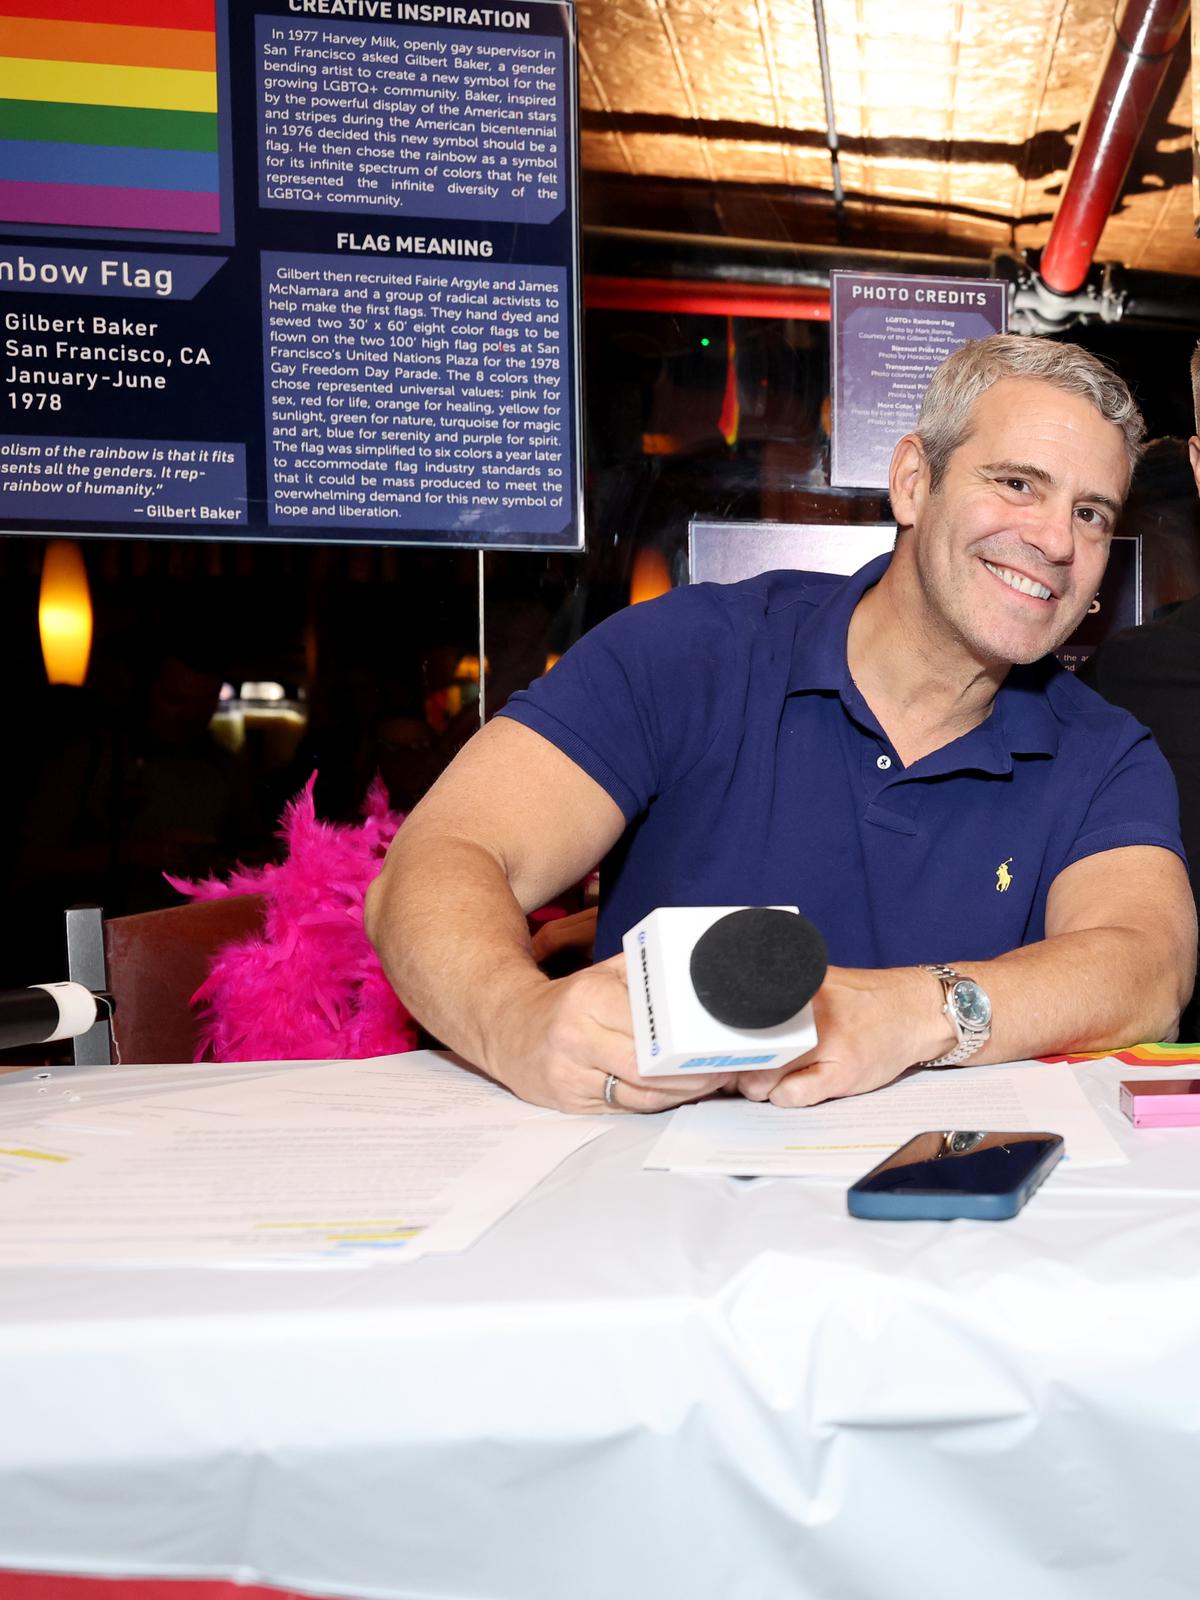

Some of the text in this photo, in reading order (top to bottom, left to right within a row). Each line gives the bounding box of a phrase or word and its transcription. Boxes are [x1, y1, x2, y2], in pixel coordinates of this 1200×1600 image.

[289, 0, 529, 28] CREATIVE INSPIRATION
[273, 29, 555, 59] In 1977 Harvey Milk, openly gay supervisor in
[264, 60, 556, 90] bending artist to create a new symbol for the
[265, 92, 556, 122] by the powerful display of the American stars
[266, 124, 557, 152] in 1976 decided this new symbol should be a
[266, 155, 557, 184] for its infinite spectrum of colors that he felt
[268, 187, 403, 208] LGBTQ+ community.
[337, 233, 493, 257] FLAG MEANING
[102, 261, 172, 295] Flag
[277, 268, 558, 292] Gilbert then recruited Fairie Argyle and James
[853, 285, 986, 305] PHOTO CREDITS
[6, 313, 158, 336] Gilbert Baker
[6, 340, 210, 367] San Francisco, CA
[6, 366, 165, 390] January-June
[271, 362, 560, 387] Gay Freedom Day Parade. The 8 colors they
[9, 393, 61, 410] 1978
[273, 410, 561, 433] sunlight, green for nature, turquoise for magic
[45, 445, 60, 456] of
[63, 446, 86, 457] the
[90, 447, 149, 459] rainbow
[152, 448, 163, 460] is
[168, 449, 196, 461] that
[199, 450, 208, 462] it
[212, 451, 234, 463] fits
[45, 463, 63, 474] all
[67, 464, 90, 475] the
[94, 465, 156, 479] genders.
[161, 467, 171, 478] It
[175, 470, 205, 482] rep-
[3, 480, 63, 492] rainbow
[67, 481, 82, 493] of
[147, 505, 196, 518] Gilbert
[200, 507, 241, 519] Baker
[275, 504, 401, 517] hope and liberation.
